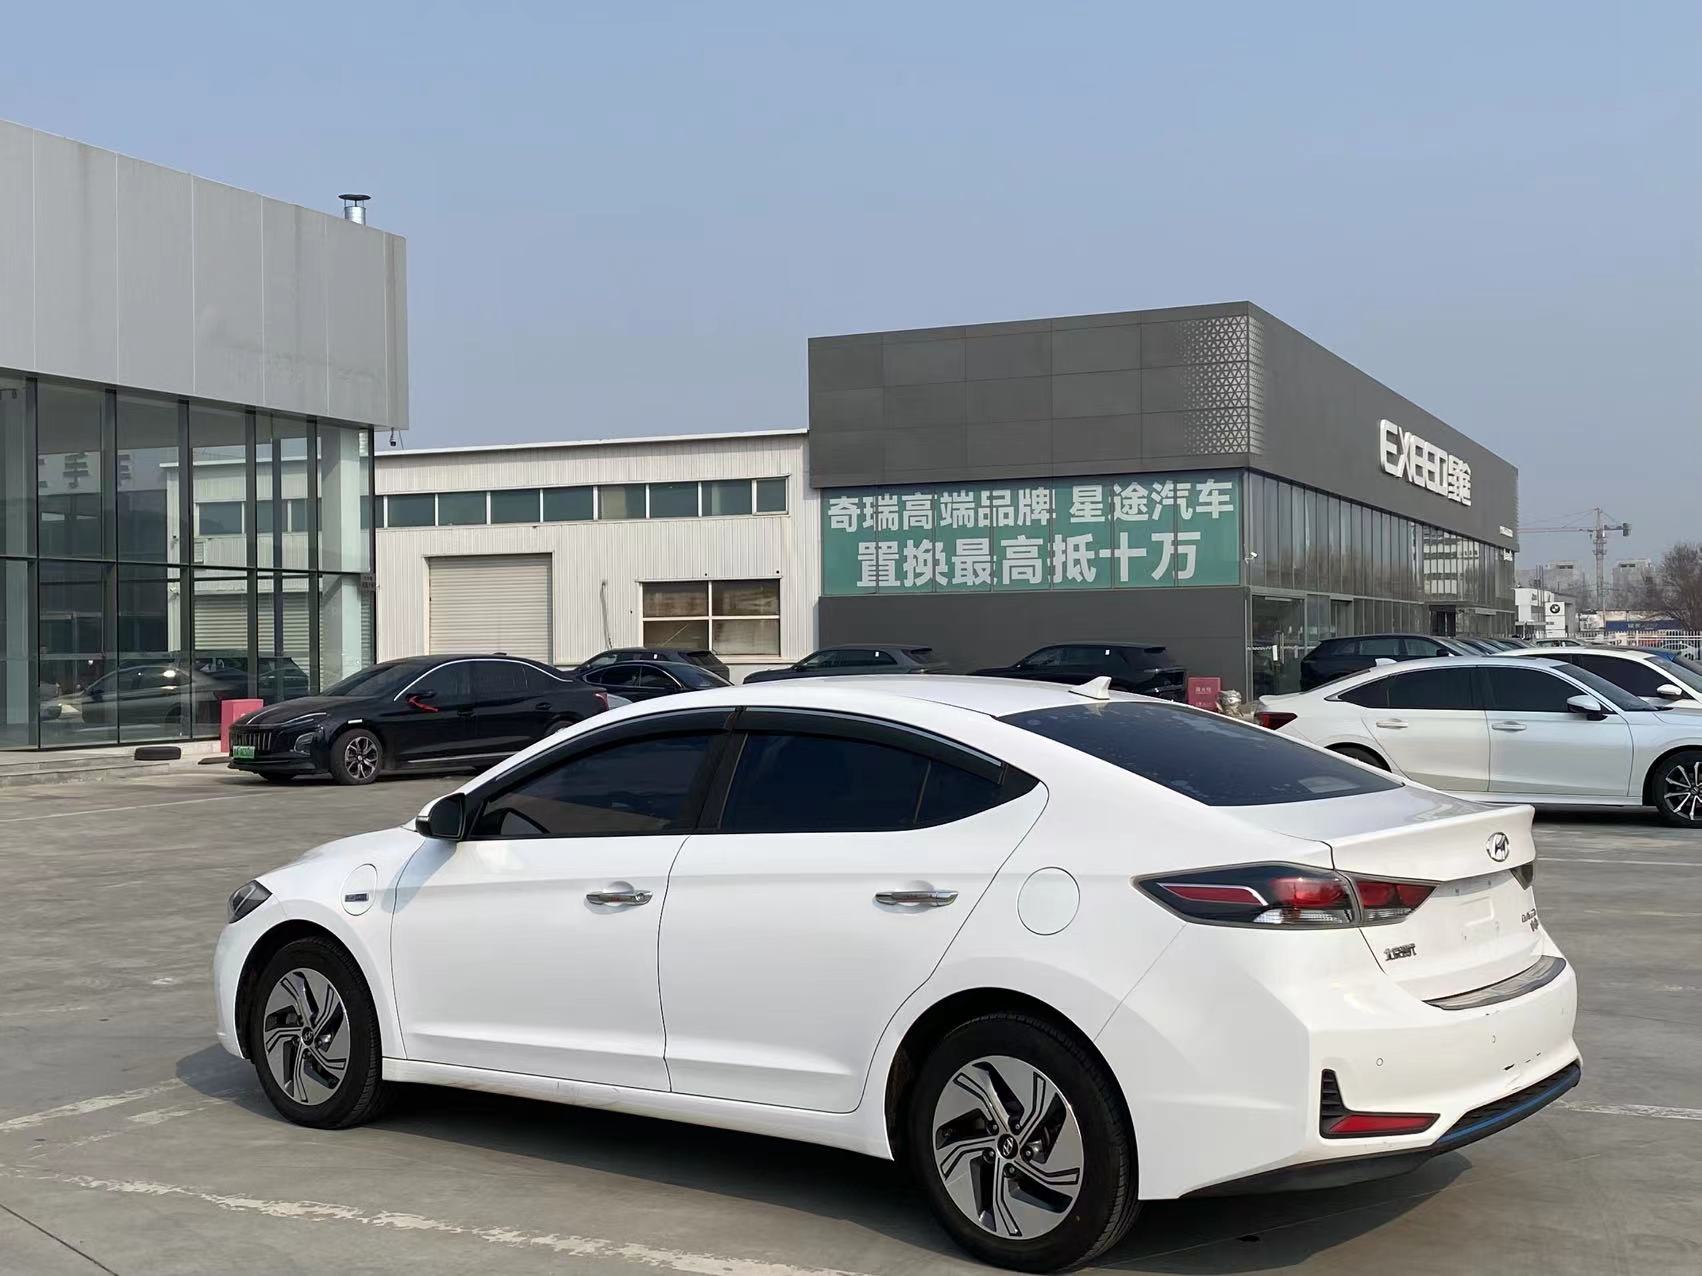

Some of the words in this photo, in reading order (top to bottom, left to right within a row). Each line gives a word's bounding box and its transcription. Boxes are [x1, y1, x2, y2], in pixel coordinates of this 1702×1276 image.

[828, 487, 1056, 532] 奇瑞高端品牌
[1069, 479, 1234, 524] 星途汽车
[857, 532, 1201, 587] 置换最高抵十万
